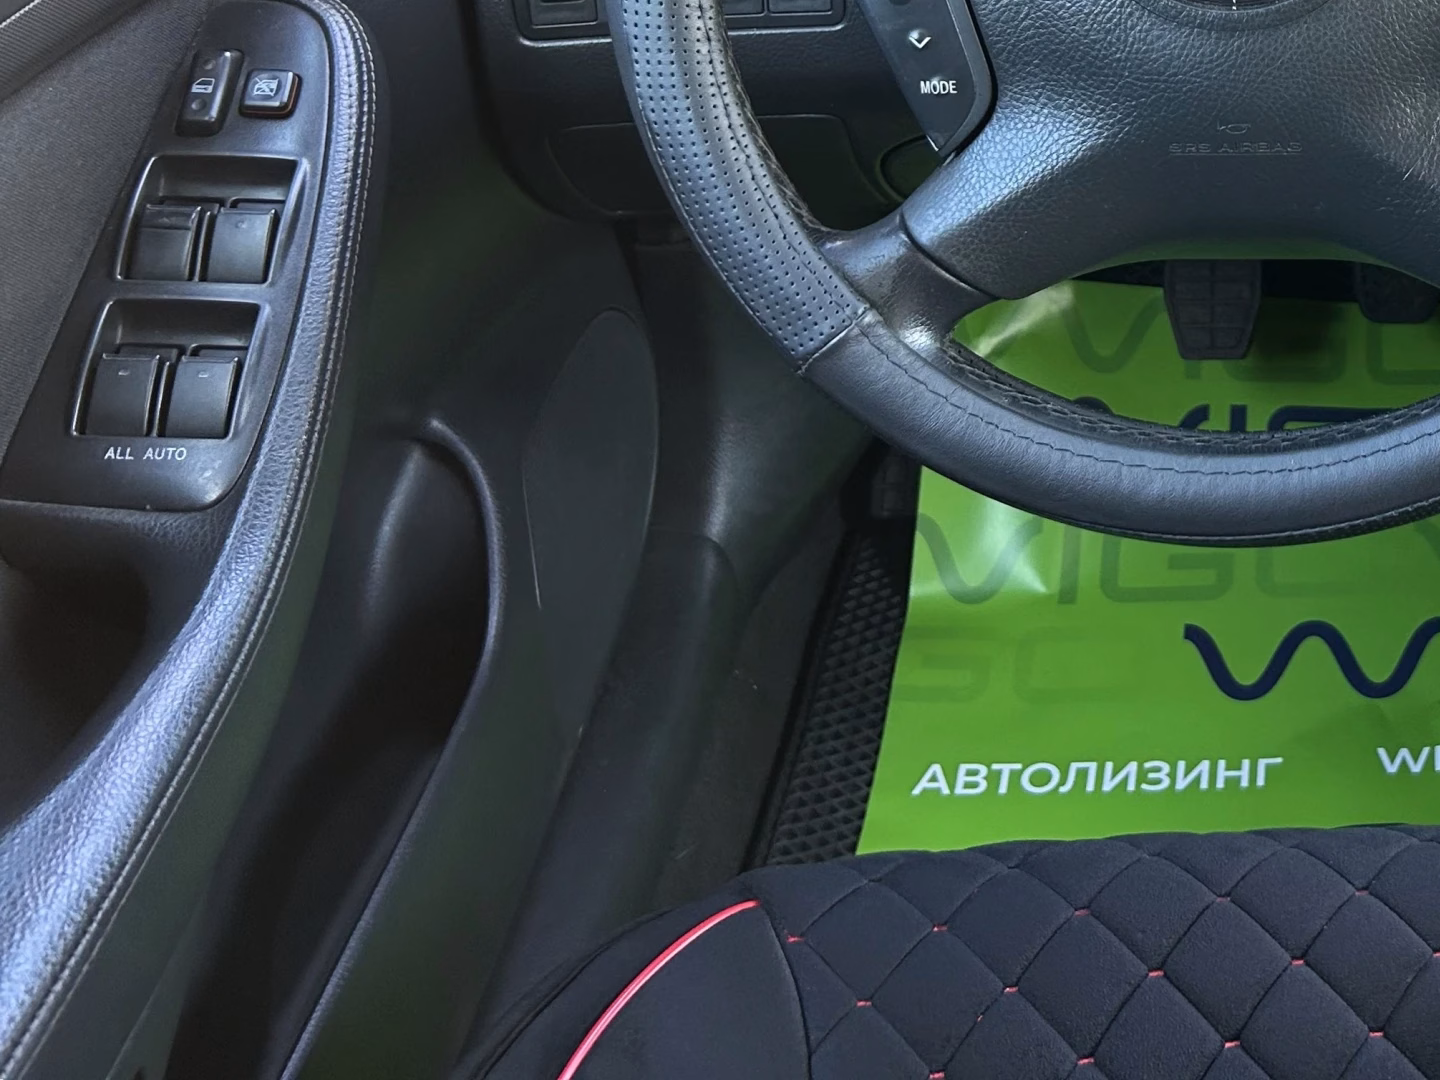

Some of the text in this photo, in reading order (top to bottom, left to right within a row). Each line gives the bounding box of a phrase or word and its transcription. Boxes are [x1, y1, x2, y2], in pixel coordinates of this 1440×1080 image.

[920, 80, 957, 95] MODE
[104, 447, 187, 461] ALL AUTO
[911, 757, 1283, 795] АВТОЛИЗИНГ
